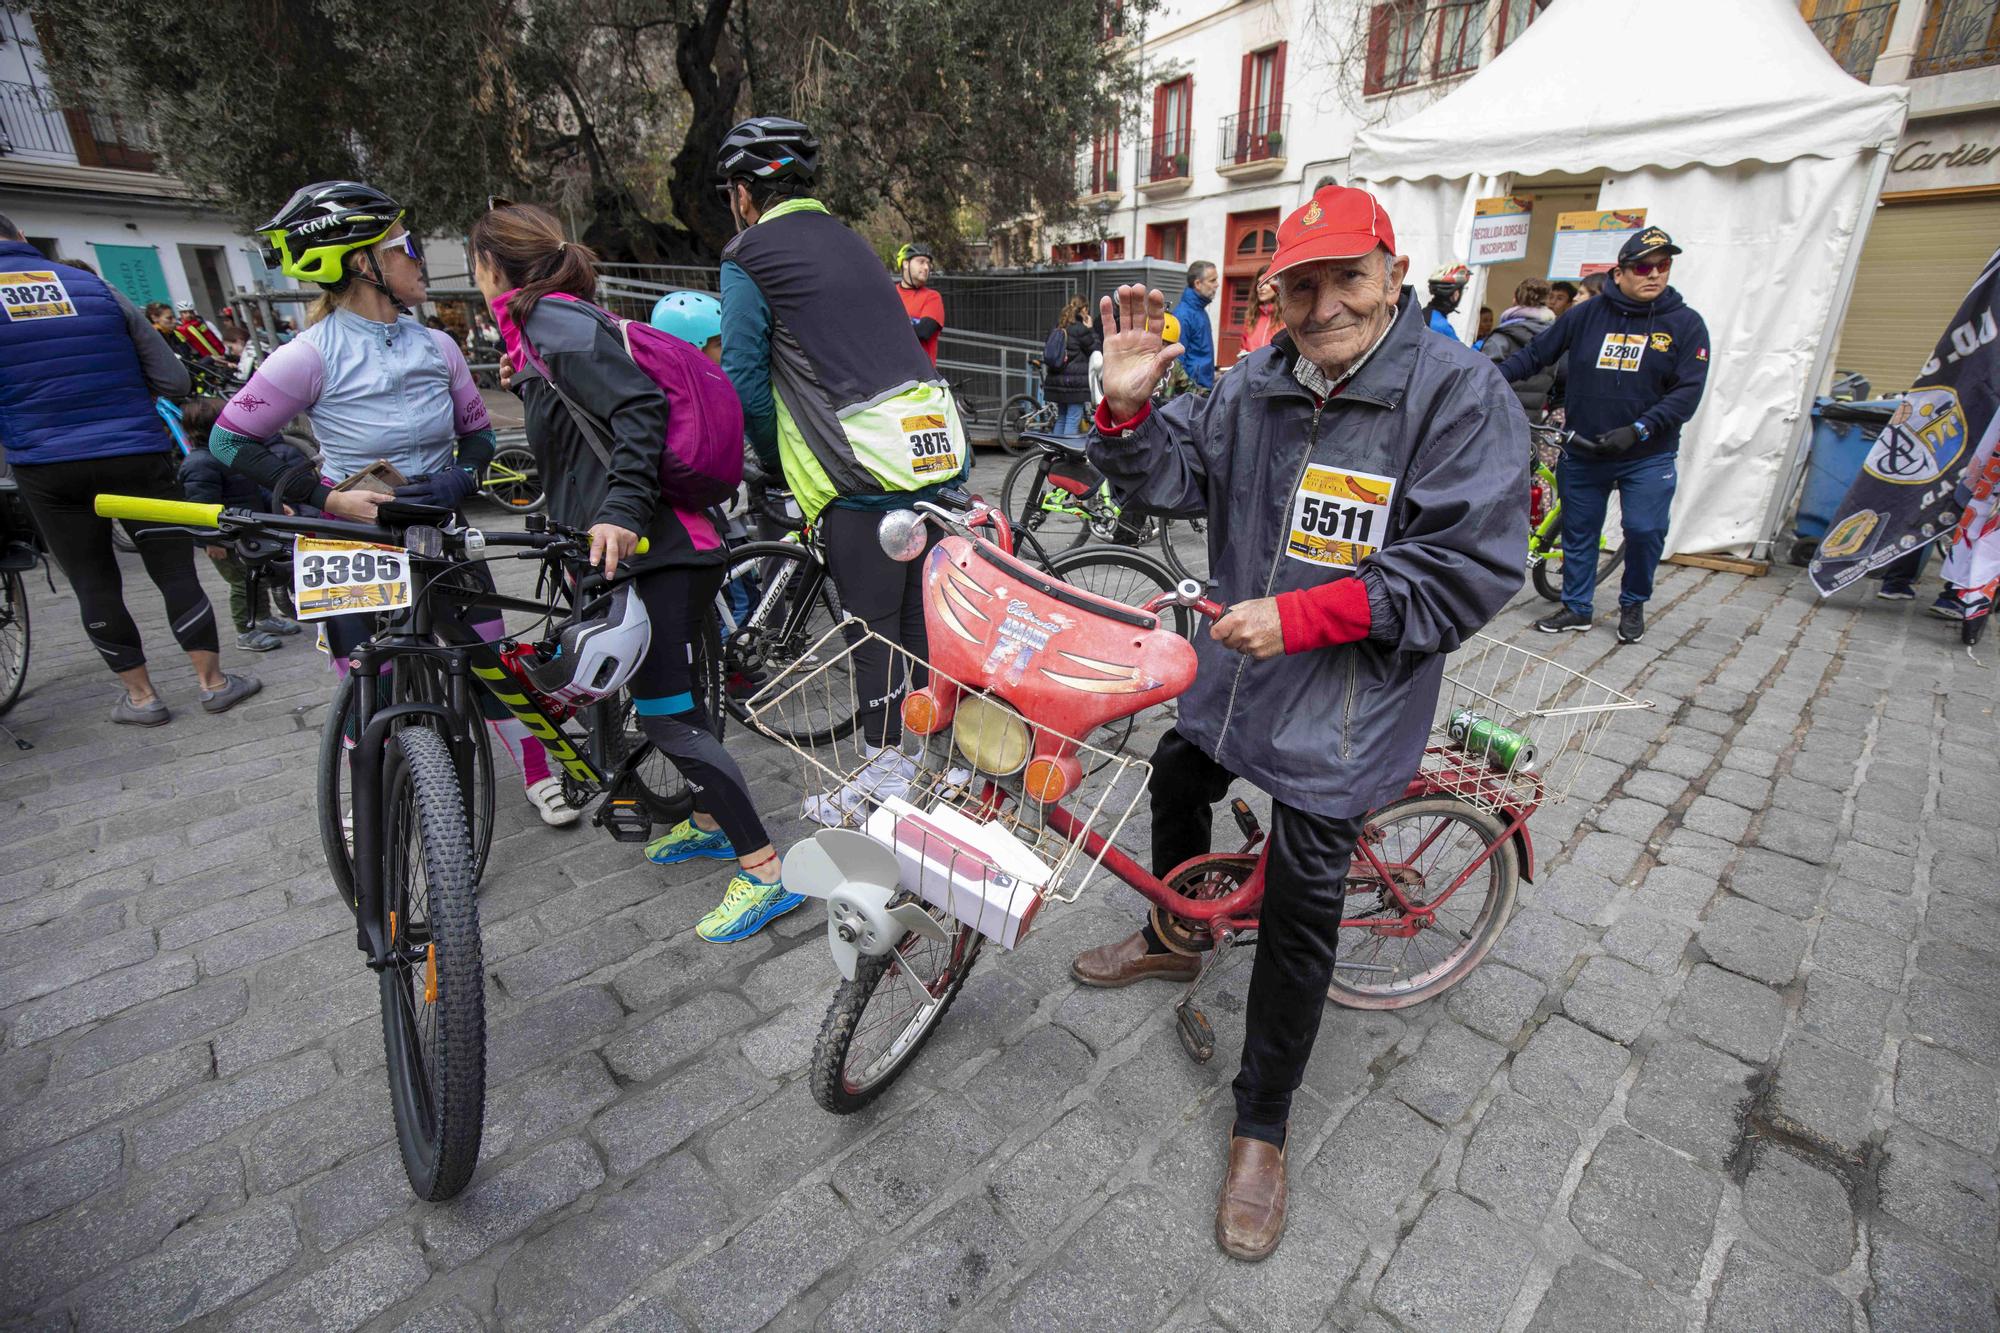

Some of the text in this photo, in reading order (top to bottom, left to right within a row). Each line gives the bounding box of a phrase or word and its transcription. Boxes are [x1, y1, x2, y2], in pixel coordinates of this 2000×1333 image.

[1890, 140, 2000, 173] Cartier
[298, 214, 342, 235] KASK
[1474, 223, 1528, 240] RECOLLIDA DORSALS
[1480, 240, 1518, 255] INSCRIPCIONS
[2, 284, 63, 305] 3823
[1604, 344, 1640, 359] 5280
[910, 431, 951, 457] 3875
[1301, 497, 1374, 542] 5511
[302, 552, 401, 588] 3395
[754, 571, 789, 630] OCKRIDER
